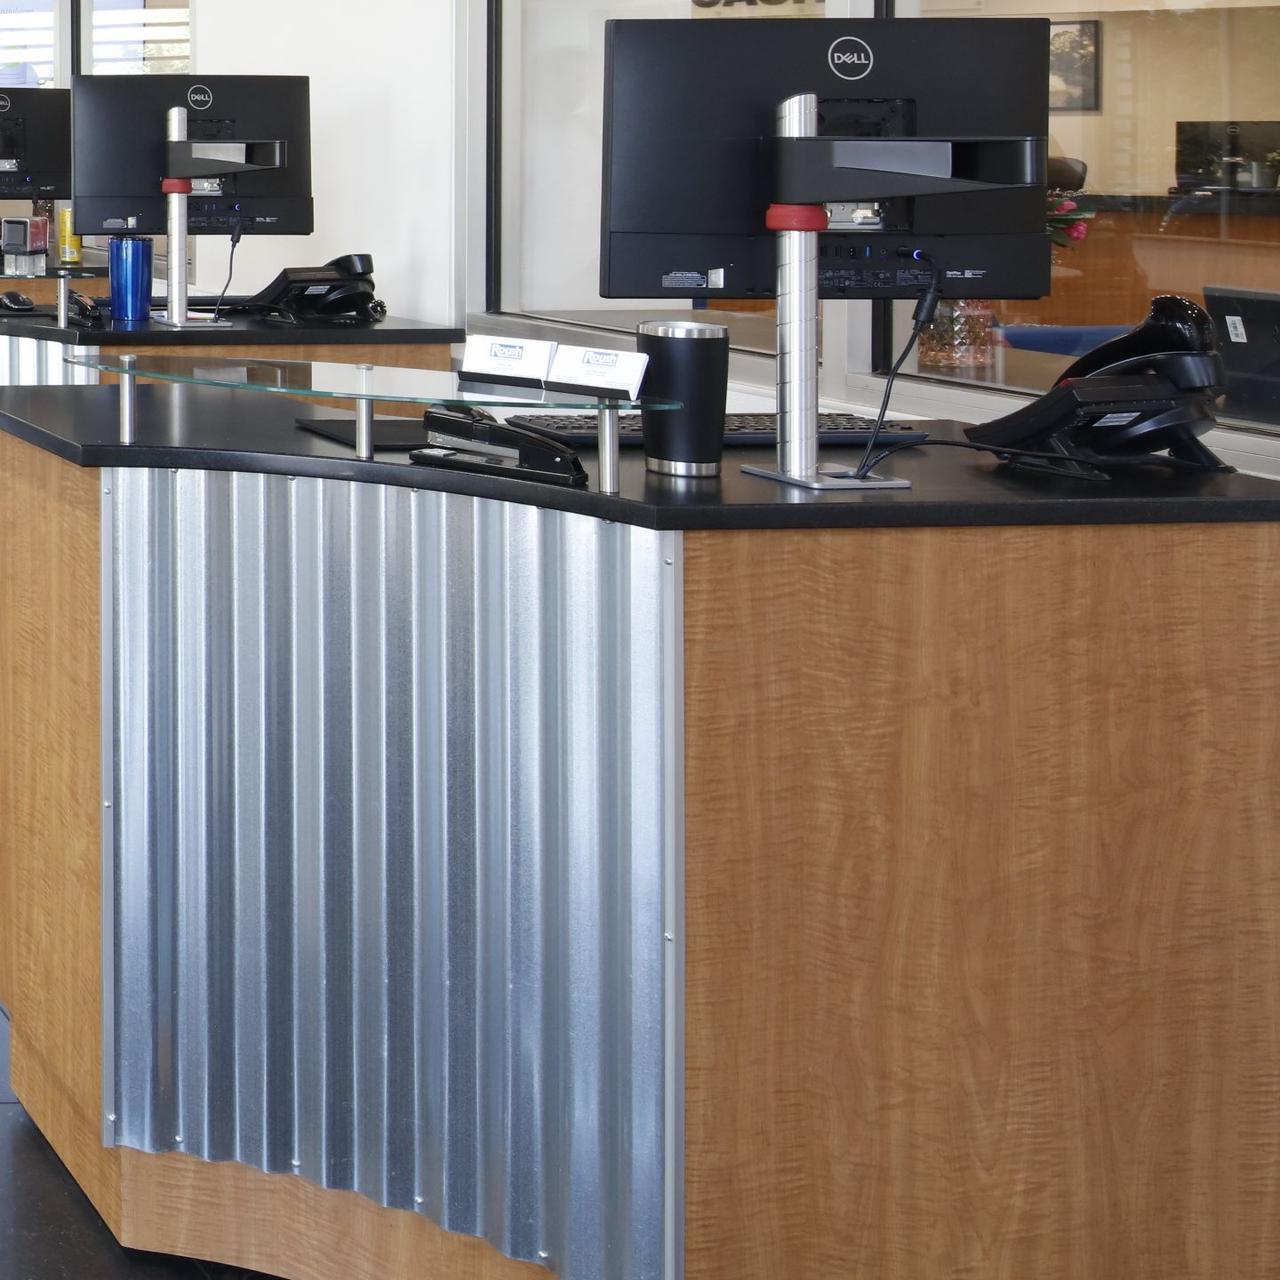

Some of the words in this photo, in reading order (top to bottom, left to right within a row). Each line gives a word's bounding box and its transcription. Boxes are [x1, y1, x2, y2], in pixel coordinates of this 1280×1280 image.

[833, 52, 869, 64] DELL
[190, 93, 210, 101] DELL
[490, 343, 523, 359] Roush
[583, 351, 618, 366] Roush
